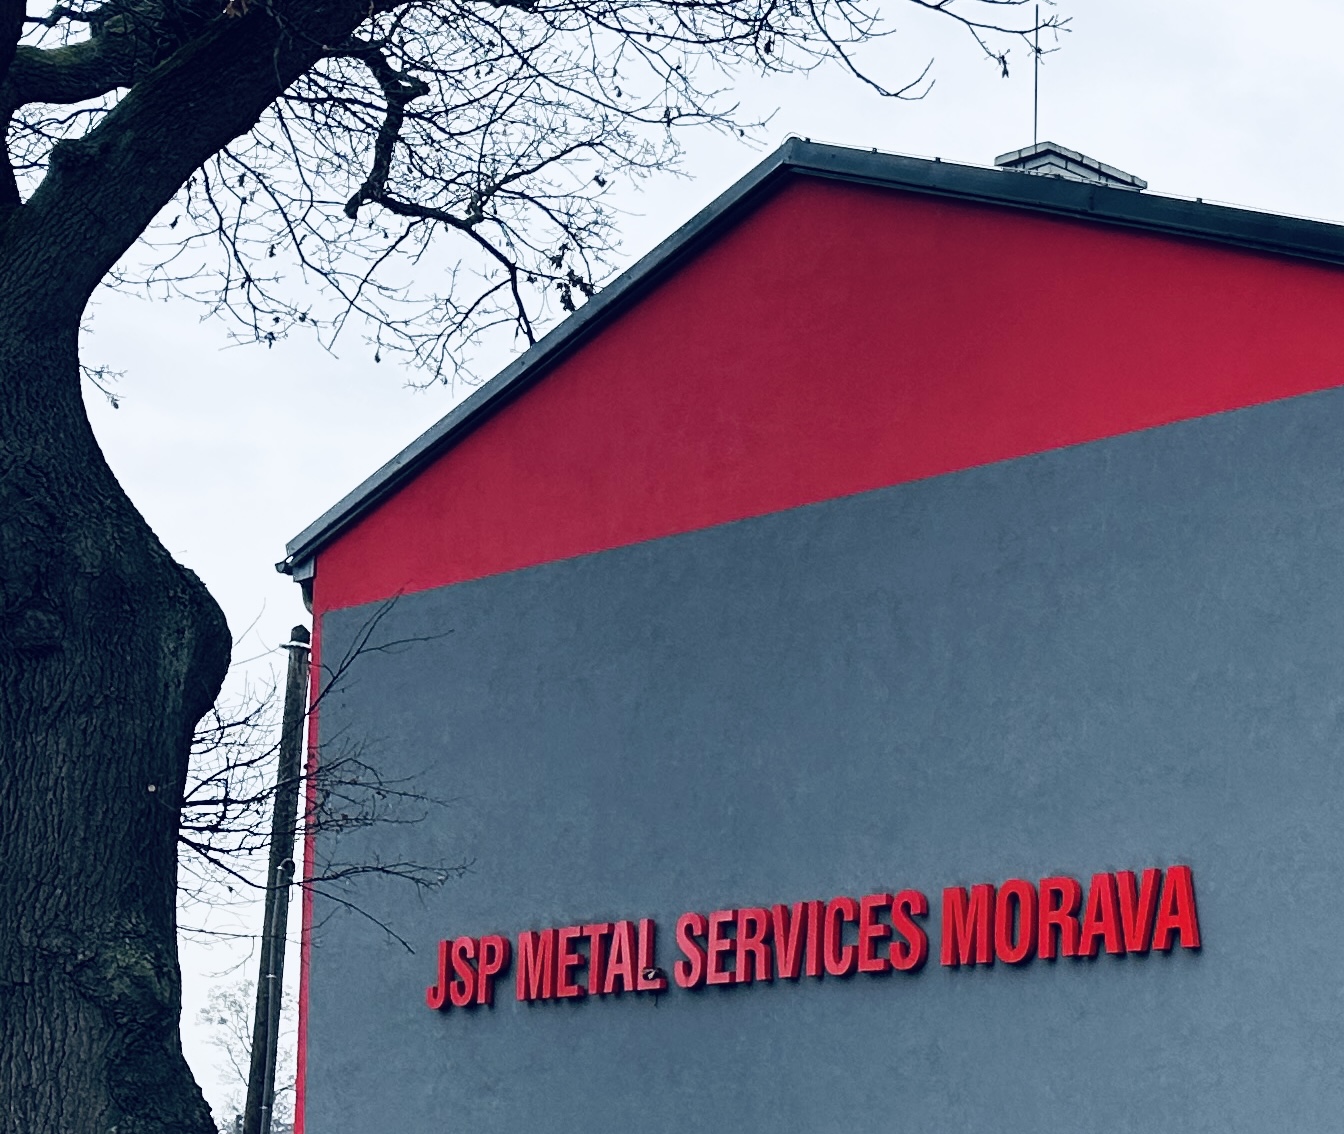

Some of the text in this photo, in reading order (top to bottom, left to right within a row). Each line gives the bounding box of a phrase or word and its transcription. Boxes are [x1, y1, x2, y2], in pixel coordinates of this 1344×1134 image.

[425, 864, 1201, 1011] JSP METAL SERVICES MORAVA
